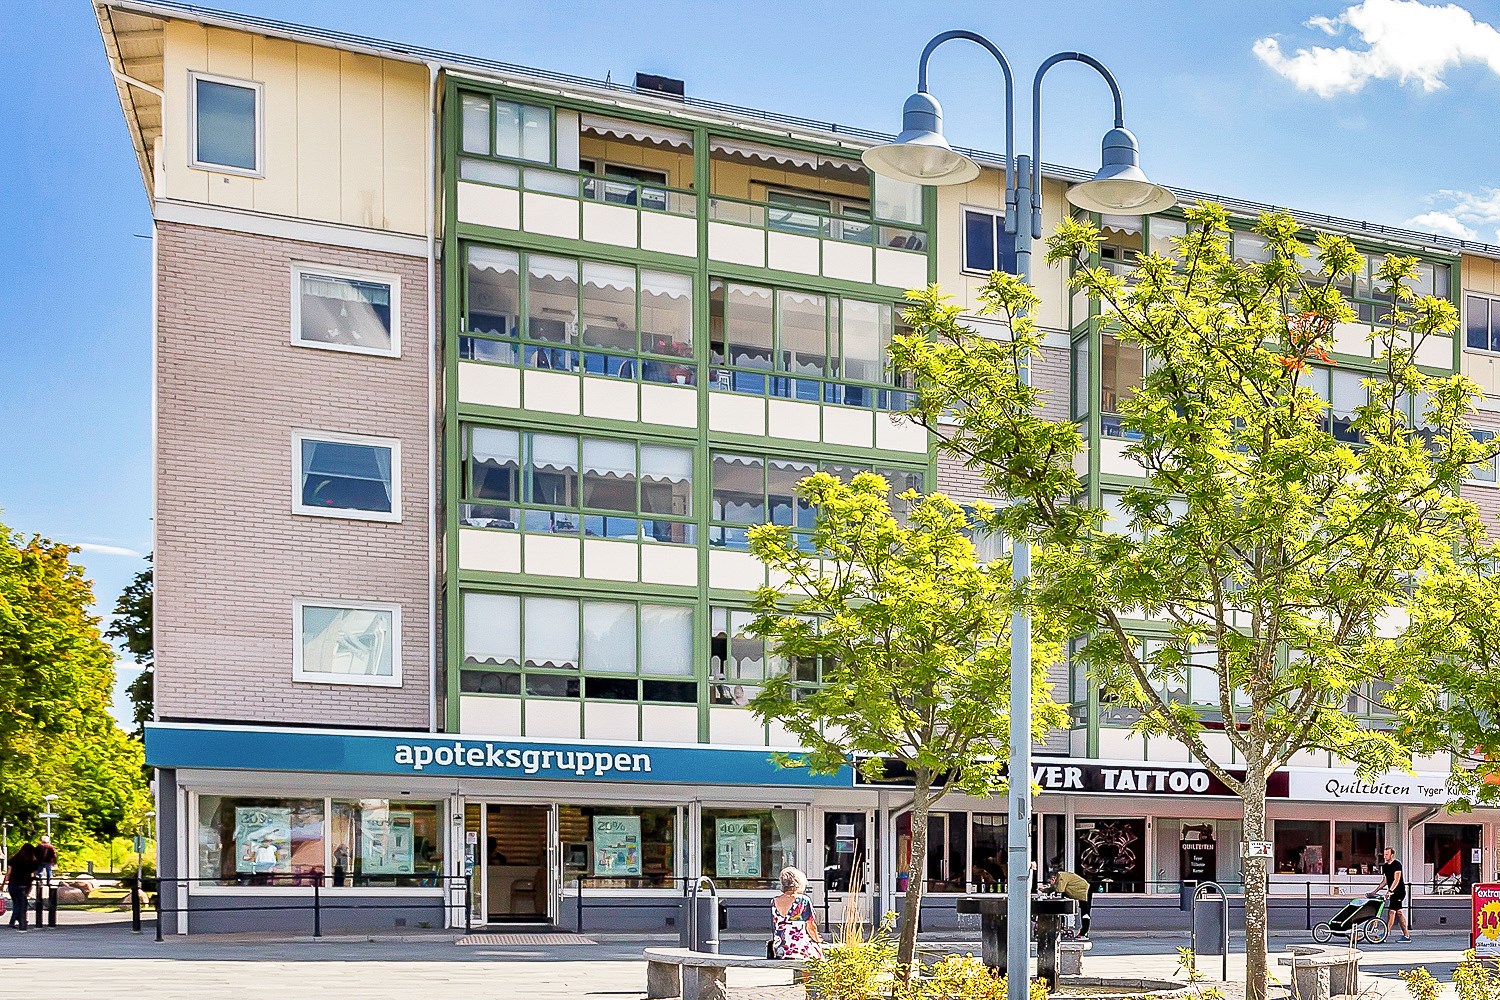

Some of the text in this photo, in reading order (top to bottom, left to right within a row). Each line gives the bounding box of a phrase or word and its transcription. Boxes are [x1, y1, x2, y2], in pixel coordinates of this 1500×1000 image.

[394, 741, 652, 776] apoteksgruppen
[1101, 768, 1210, 793] TATTOO
[1325, 778, 1410, 798] Quiltbiten
[1417, 785, 1444, 796] Tyger
